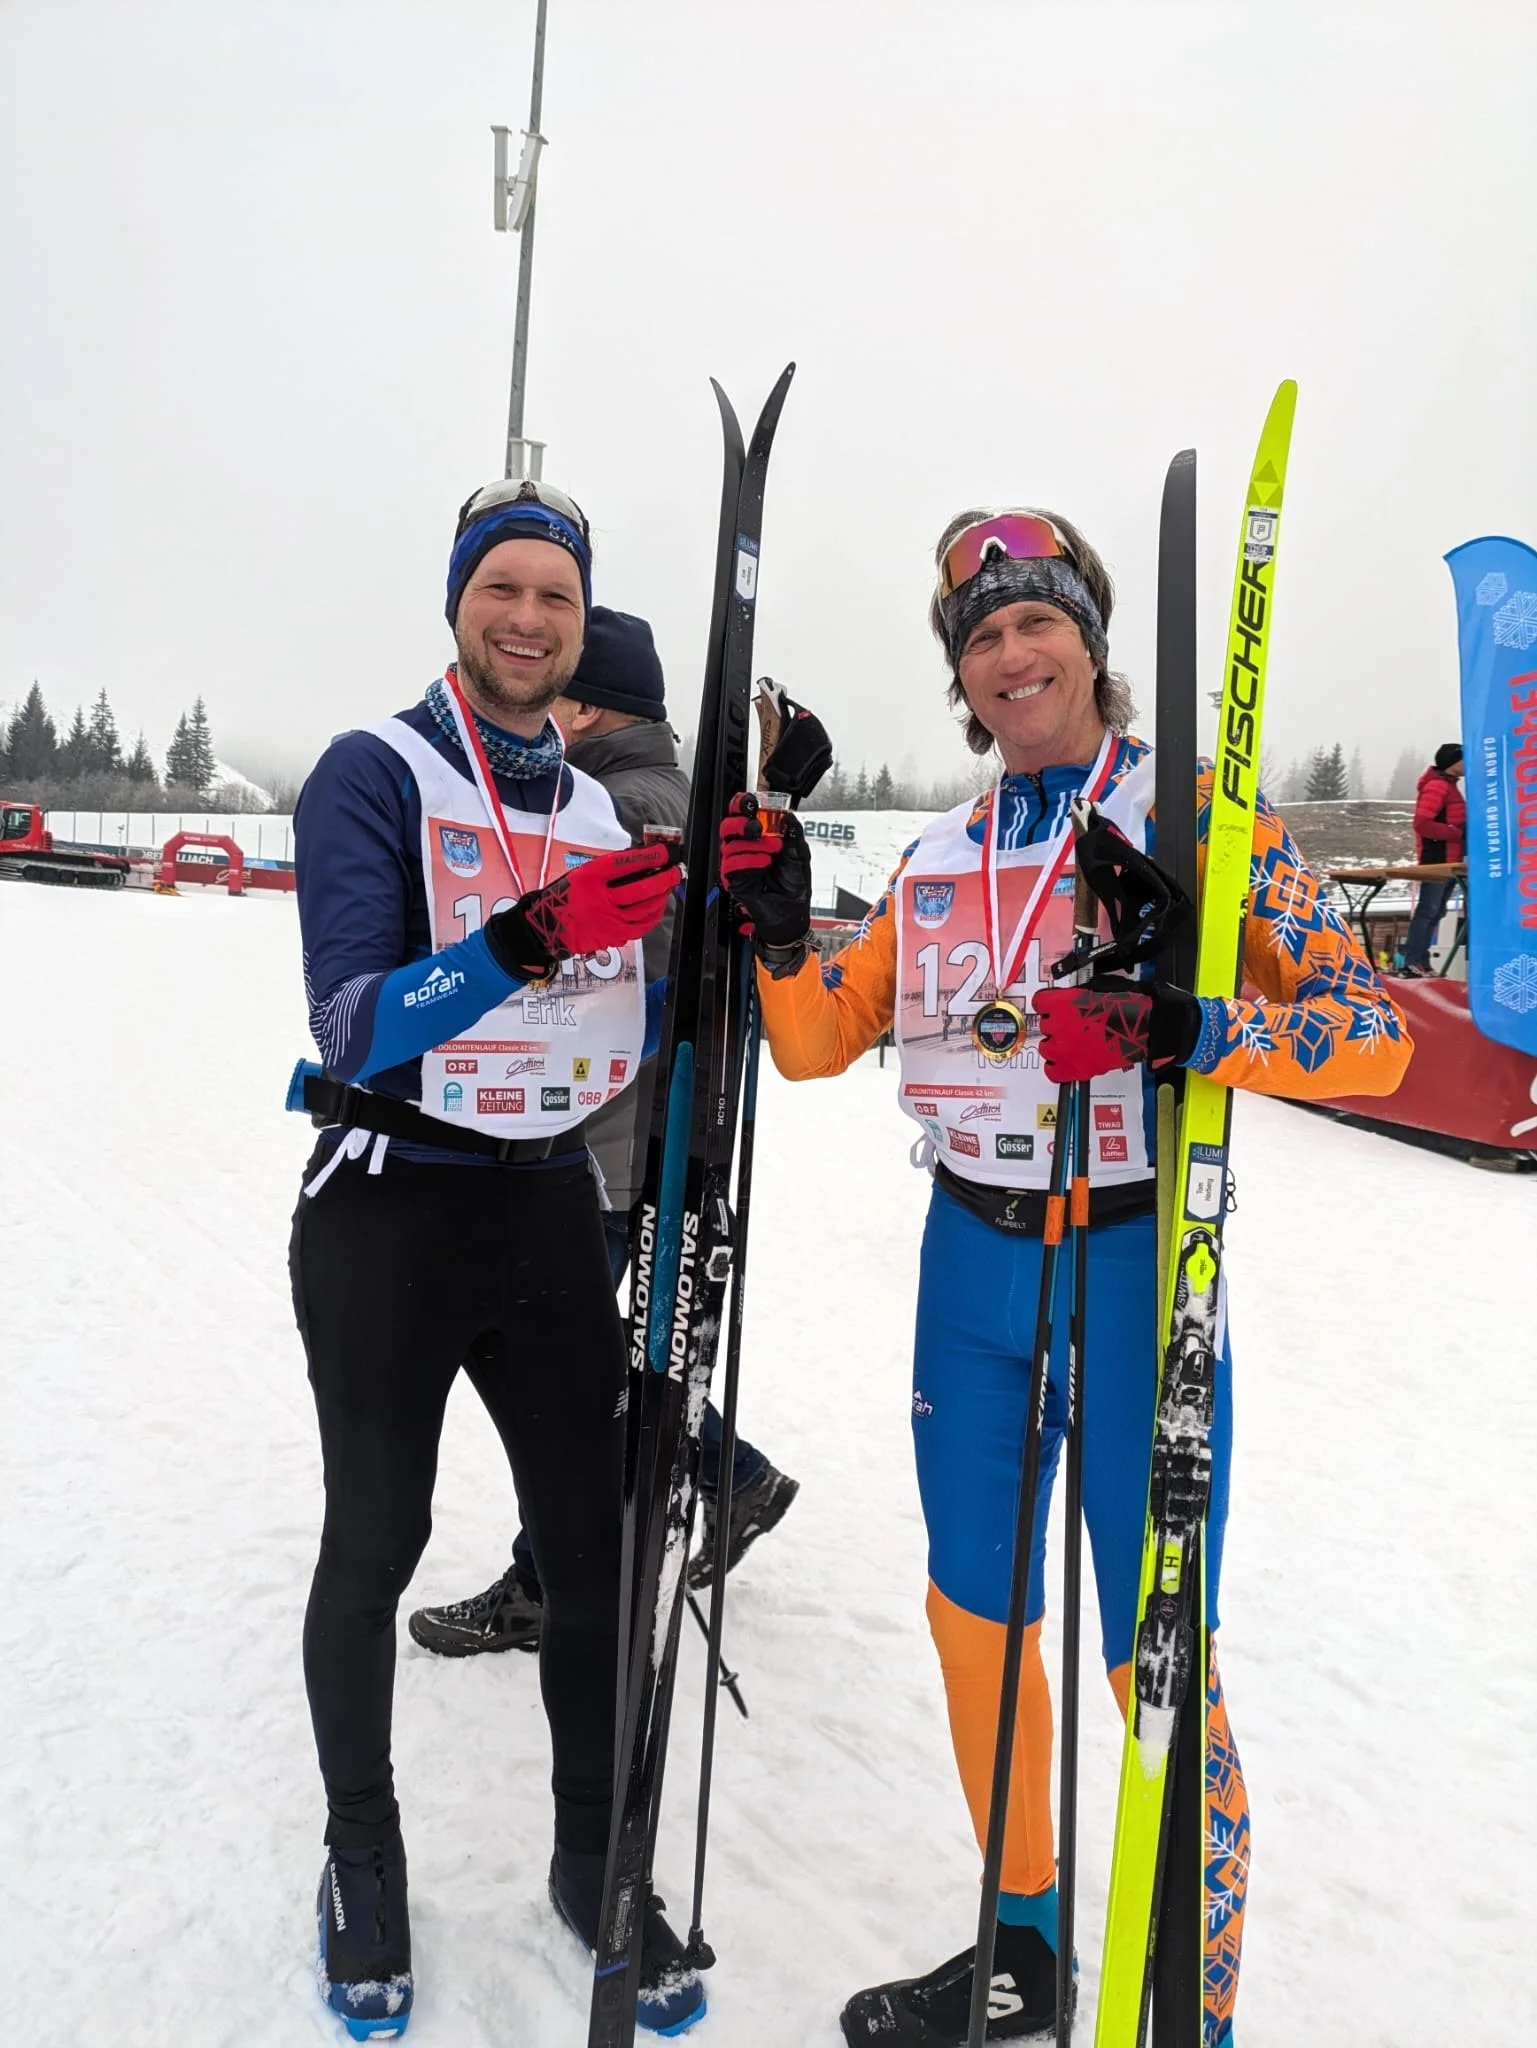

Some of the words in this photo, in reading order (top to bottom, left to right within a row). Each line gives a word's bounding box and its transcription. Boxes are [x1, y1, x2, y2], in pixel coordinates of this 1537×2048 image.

[804, 820, 855, 841] 2026
[403, 970, 466, 1008] Borah
[415, 987, 459, 1009] TEAMWEAR
[522, 997, 577, 1026] Erik
[448, 1062, 476, 1072] ORF
[479, 1090, 523, 1101] KLEINE
[542, 1089, 569, 1107] Gösser
[479, 1102, 523, 1113] ZEITUNG
[717, 1097, 725, 1126] RC10
[916, 1105, 936, 1115] ORF
[949, 1130, 977, 1145] KLEINE
[997, 1137, 1032, 1154] Gösser
[951, 1139, 979, 1155] ZEITUNG
[1200, 1145, 1223, 1158] LUMI
[631, 1204, 656, 1372] SALOMON
[669, 1210, 699, 1382] SALOMON
